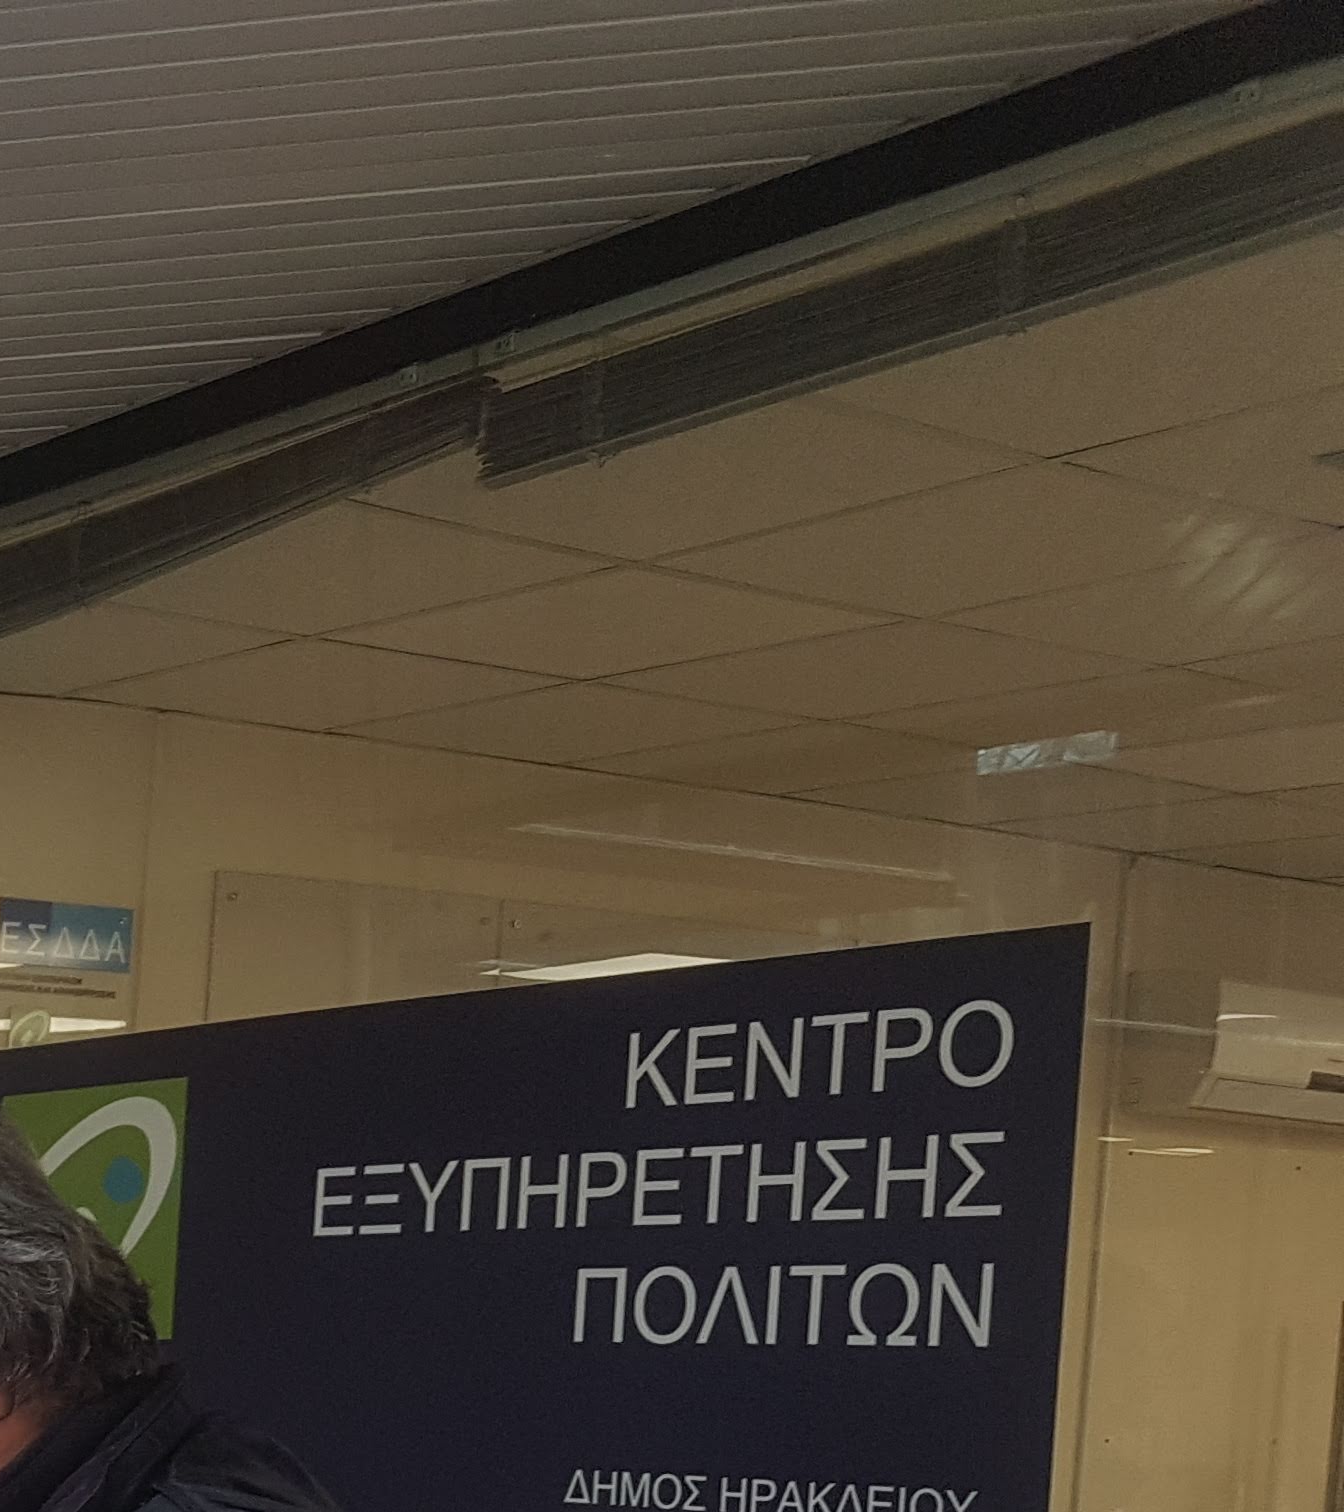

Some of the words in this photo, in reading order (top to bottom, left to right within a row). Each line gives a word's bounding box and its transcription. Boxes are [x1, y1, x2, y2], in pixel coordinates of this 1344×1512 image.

[624, 999, 1016, 1109] ΚΕΝΤΡΟ
[312, 1131, 1007, 1239] ΕΞΥΠΗΡΕΤΗΣΗΣ
[572, 1261, 995, 1349] ΠΟΛΙΤΩΝ
[562, 1467, 708, 1512] ΔΗΜΟΣ
